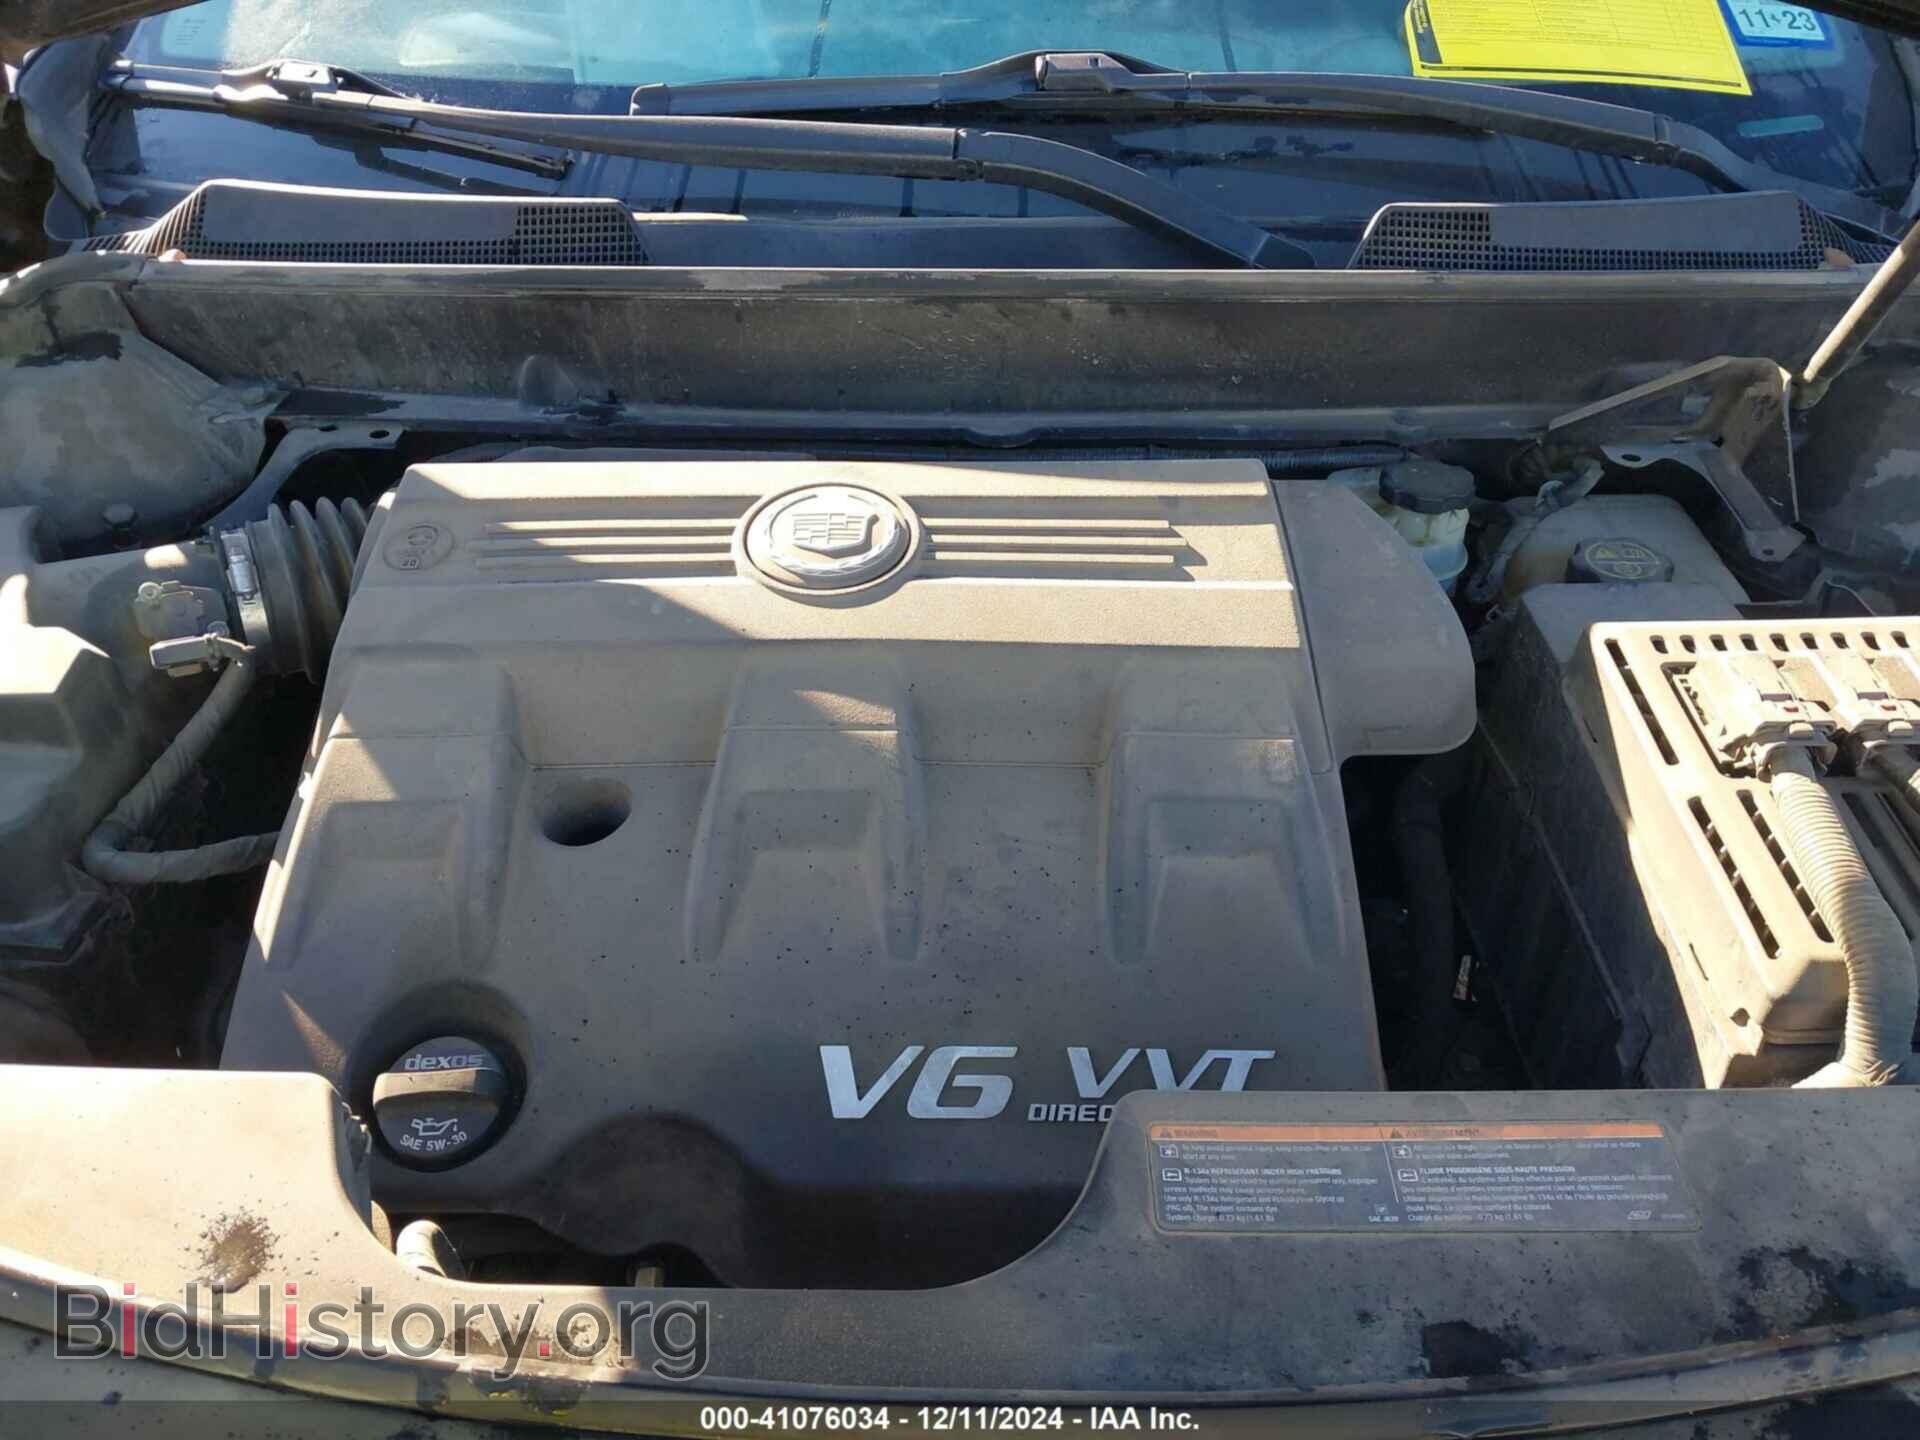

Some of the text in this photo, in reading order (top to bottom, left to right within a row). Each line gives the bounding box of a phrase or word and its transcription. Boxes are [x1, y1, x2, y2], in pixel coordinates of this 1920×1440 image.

[404, 1053, 483, 1070] dexos
[819, 1045, 1276, 1119] V6 VVT
[400, 1131, 467, 1151] SAE 5W-30
